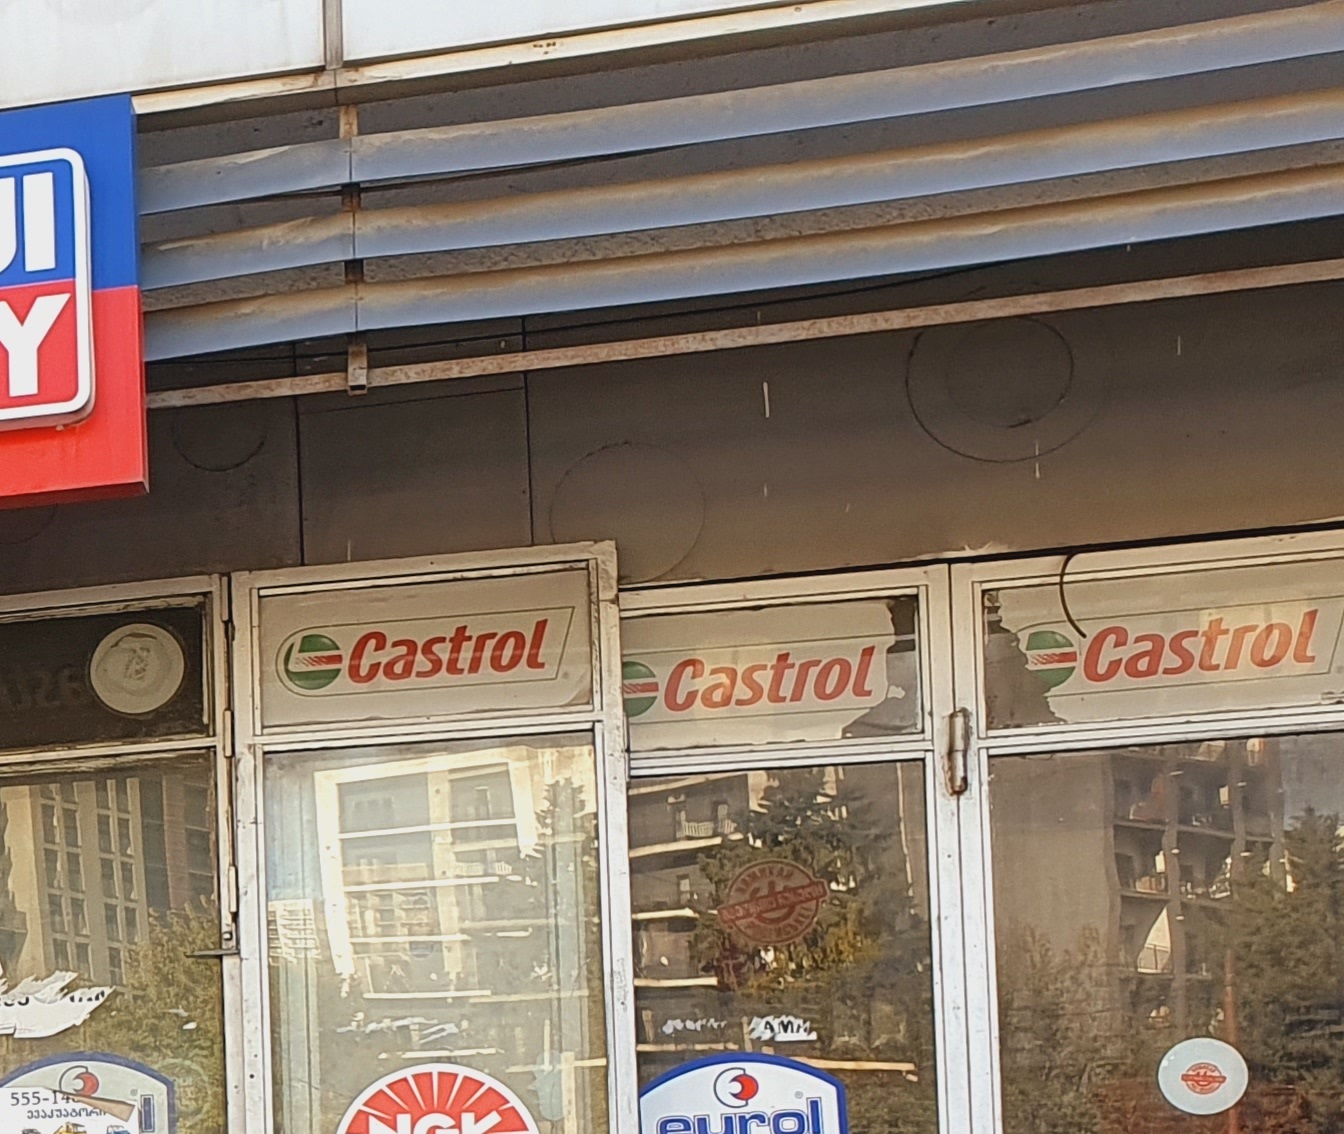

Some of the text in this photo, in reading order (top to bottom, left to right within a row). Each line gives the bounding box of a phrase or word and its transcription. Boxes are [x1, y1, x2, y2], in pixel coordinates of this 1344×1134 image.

[346, 617, 549, 684] Castrol
[663, 645, 876, 713] Castrol
[1082, 608, 1319, 684] Castrol
